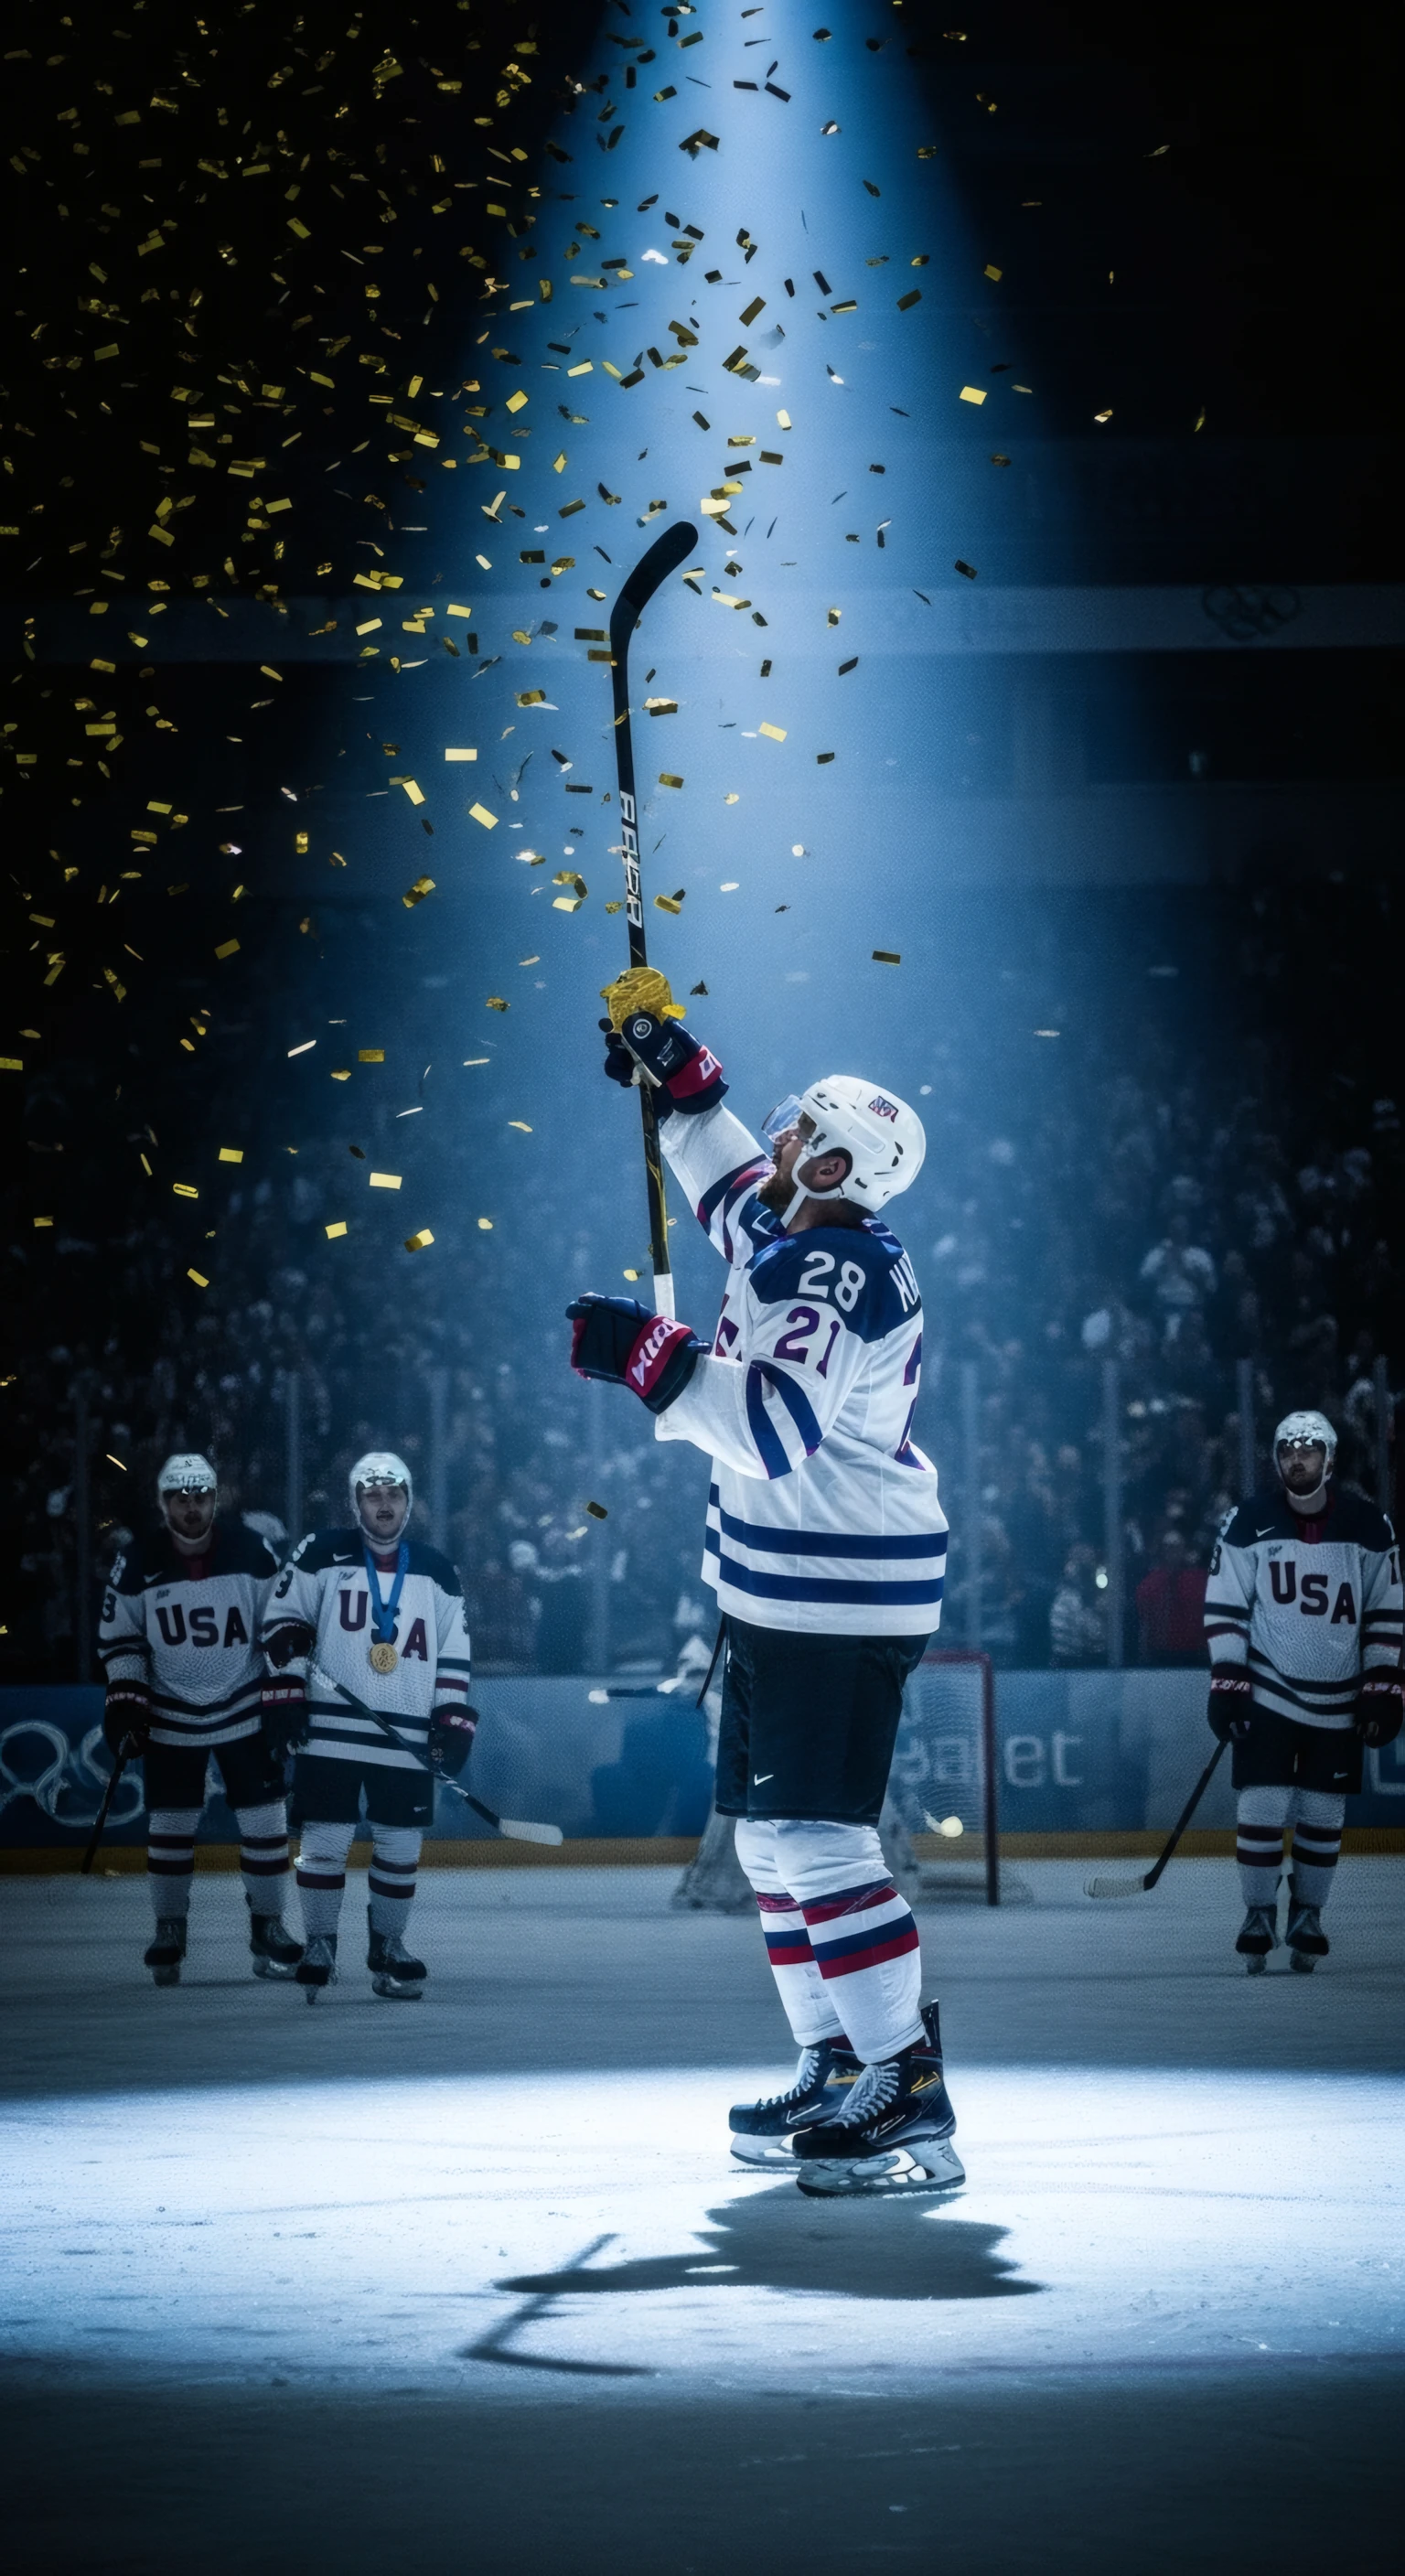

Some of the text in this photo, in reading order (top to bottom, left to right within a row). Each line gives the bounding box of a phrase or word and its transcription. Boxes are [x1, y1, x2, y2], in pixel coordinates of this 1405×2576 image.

[798, 1250, 866, 1312] 28
[773, 1305, 840, 1379] 21
[1269, 1561, 1357, 1624] USA
[156, 1605, 249, 1648] USA
